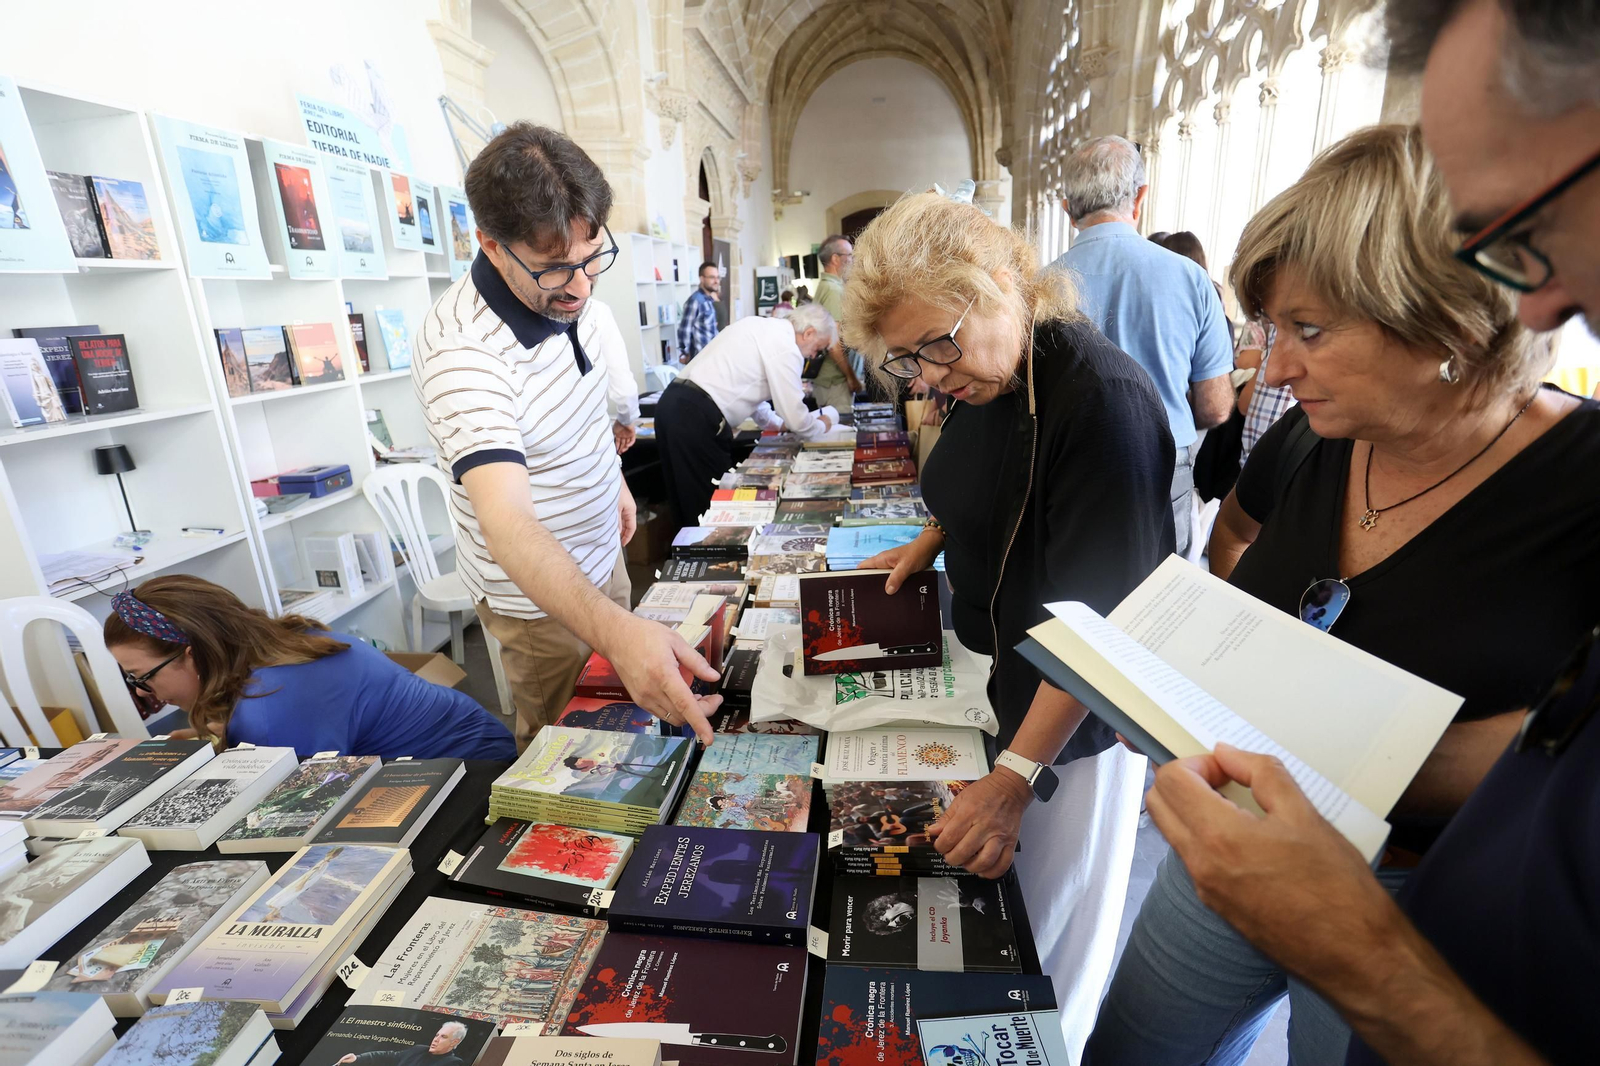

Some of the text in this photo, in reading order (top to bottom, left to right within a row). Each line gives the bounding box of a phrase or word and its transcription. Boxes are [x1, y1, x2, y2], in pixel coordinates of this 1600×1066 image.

[300, 100, 344, 119] FERIA DEL LIBRO
[306, 119, 360, 144] EDITORIAL
[311, 140, 390, 169] TIERRA DE NADIE
[40, 345, 69, 353] EXPEDI
[46, 354, 72, 362] JEREZ
[508, 734, 570, 786] Fosforito
[867, 747, 879, 766] Origen
[879, 752, 889, 775] historia
[897, 734, 908, 776] FLAMENCO
[764, 845, 775, 873] Paranormales
[642, 869, 653, 888] Adrián
[653, 836, 691, 906] EXPEDIENTES
[678, 844, 705, 899] JEREZANOS
[590, 890, 603, 907] 20€
[750, 879, 761, 906] Testimonios
[929, 906, 936, 916] CD
[225, 924, 323, 939] LA MURALLA
[672, 924, 753, 937] EXPEDIENTES JEREZANOS
[842, 896, 854, 957] Morir para vencer
[236, 941, 287, 950] invisible
[384, 922, 431, 979] Las Fronteras
[397, 960, 419, 985] Mujeres
[416, 952, 425, 960] en
[426, 930, 441, 946] Libro
[438, 920, 447, 930] del
[407, 922, 457, 987] Repartimiento de Jerez
[340, 961, 359, 980] 22€
[621, 949, 647, 998] Crónica negra
[641, 950, 657, 974] Frontera
[636, 981, 645, 990] de
[659, 981, 668, 998] Manuel
[670, 952, 678, 965] López
[413, 980, 431, 1003] Margarita
[629, 990, 641, 1009] Jerez
[625, 1009, 634, 1019] de
[865, 981, 877, 1038] Crónica negra
[355, 1019, 386, 1027] maestro
[387, 1020, 423, 1032] sinfónico
[877, 981, 886, 1062] de Jerez de la Frontera
[1010, 1016, 1036, 1050] Muerte
[327, 1031, 415, 1046] Fernando López Vargas-Machuca
[992, 1023, 1018, 1066] Tocar
[555, 1050, 614, 1060] Dos siglos de
[1026, 1050, 1038, 1059] de
